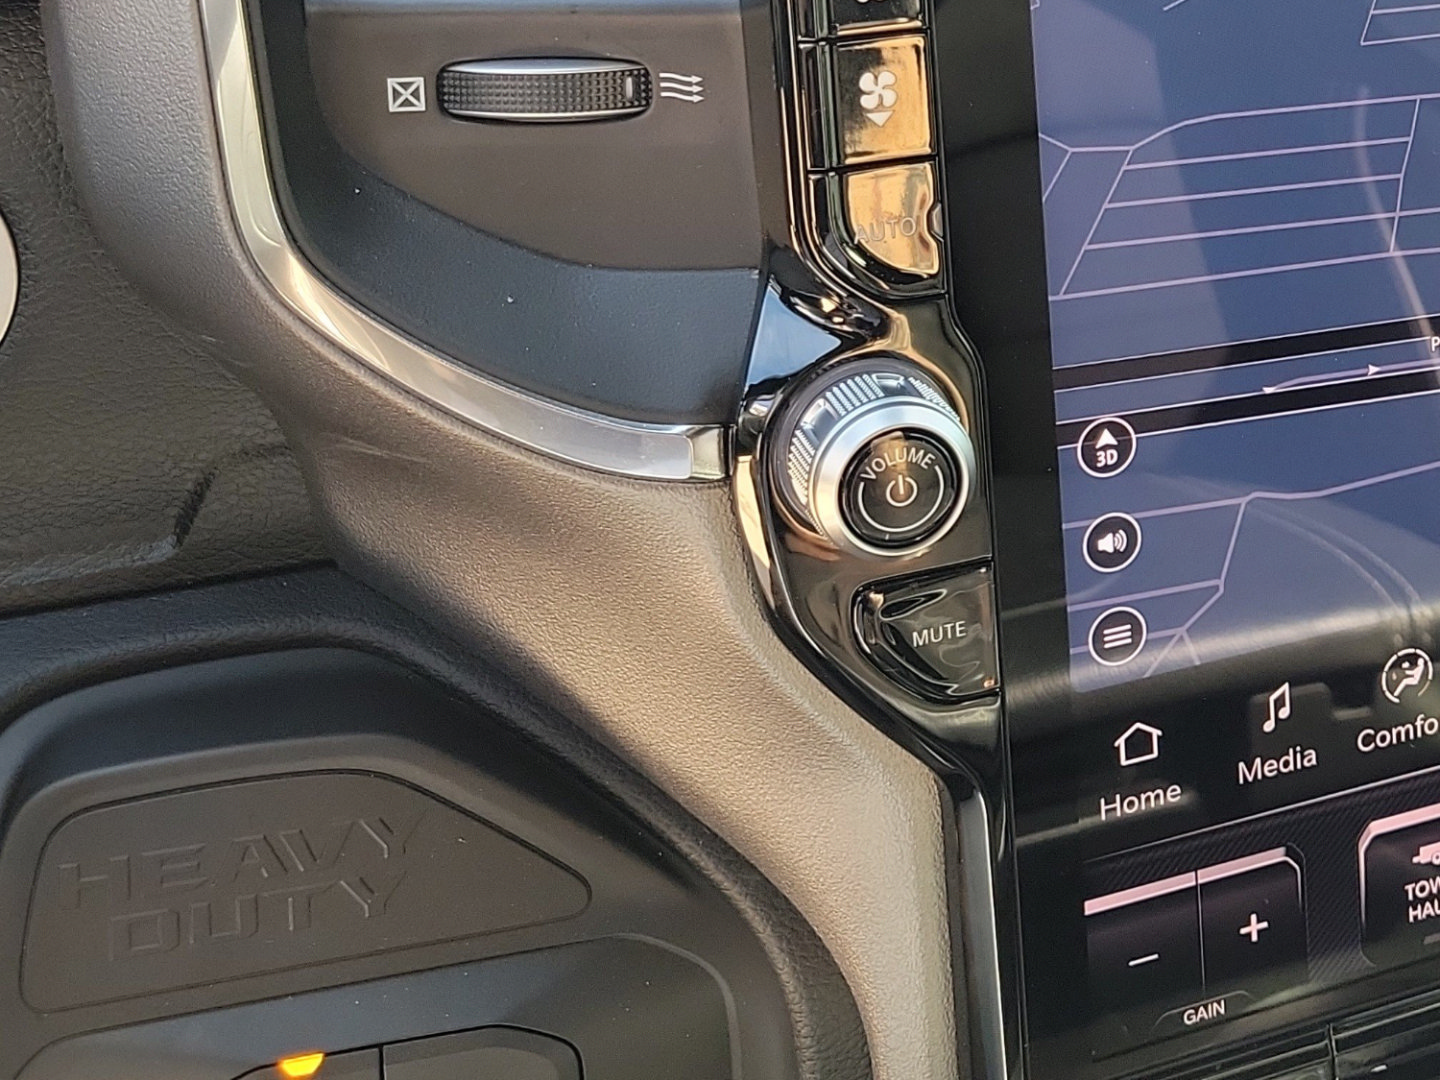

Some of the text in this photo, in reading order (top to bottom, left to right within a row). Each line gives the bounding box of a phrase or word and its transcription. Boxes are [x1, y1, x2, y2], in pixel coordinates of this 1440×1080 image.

[853, 217, 917, 246] AUTO
[860, 446, 937, 481] VOLUME
[1096, 448, 1118, 468] 3D
[912, 621, 968, 648] MUTE
[1237, 745, 1318, 784] Media
[1099, 782, 1183, 821] Home
[58, 812, 424, 911] HEAVY
[106, 870, 410, 963] DUTY
[1182, 999, 1227, 1026] GAIN
